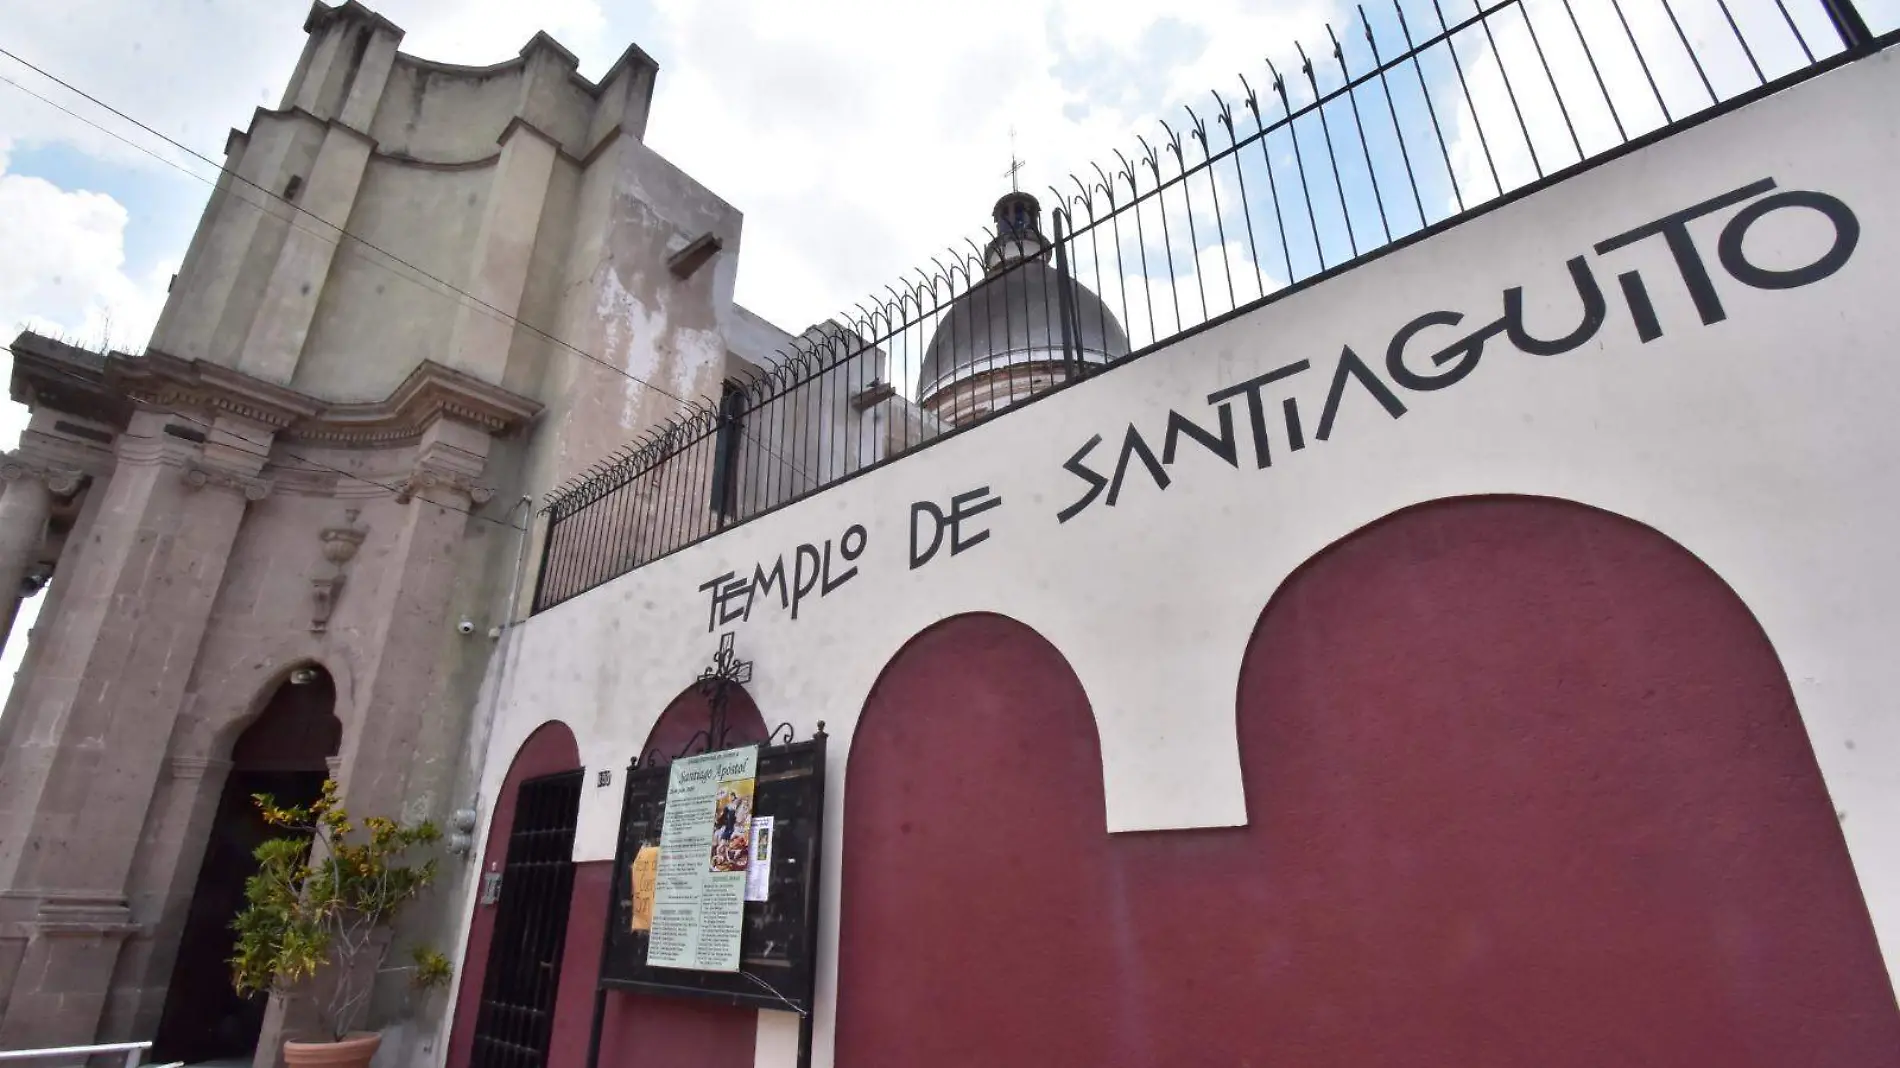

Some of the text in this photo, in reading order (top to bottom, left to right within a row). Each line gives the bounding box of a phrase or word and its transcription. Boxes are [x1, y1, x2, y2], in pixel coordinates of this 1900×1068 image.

[698, 176, 1861, 633] TEMPLO DE SANTIAGUITO
[678, 768, 713, 785] Santiago
